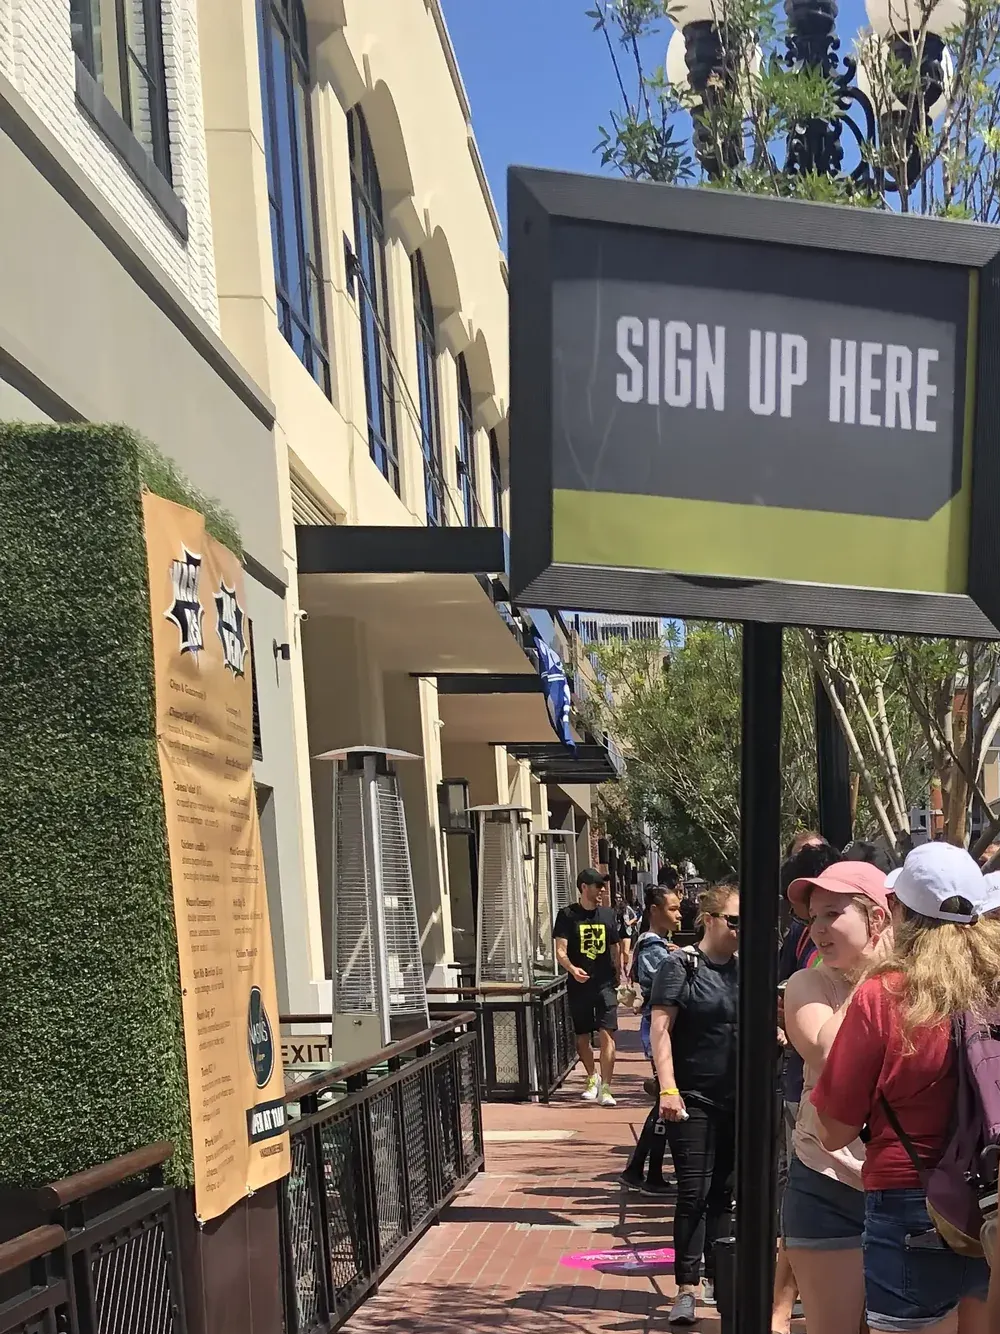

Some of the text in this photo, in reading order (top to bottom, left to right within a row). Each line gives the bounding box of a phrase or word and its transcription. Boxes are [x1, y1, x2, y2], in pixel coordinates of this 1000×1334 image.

[616, 315, 939, 432] SIGN UP HERE
[280, 1044, 327, 1064] EXIT
